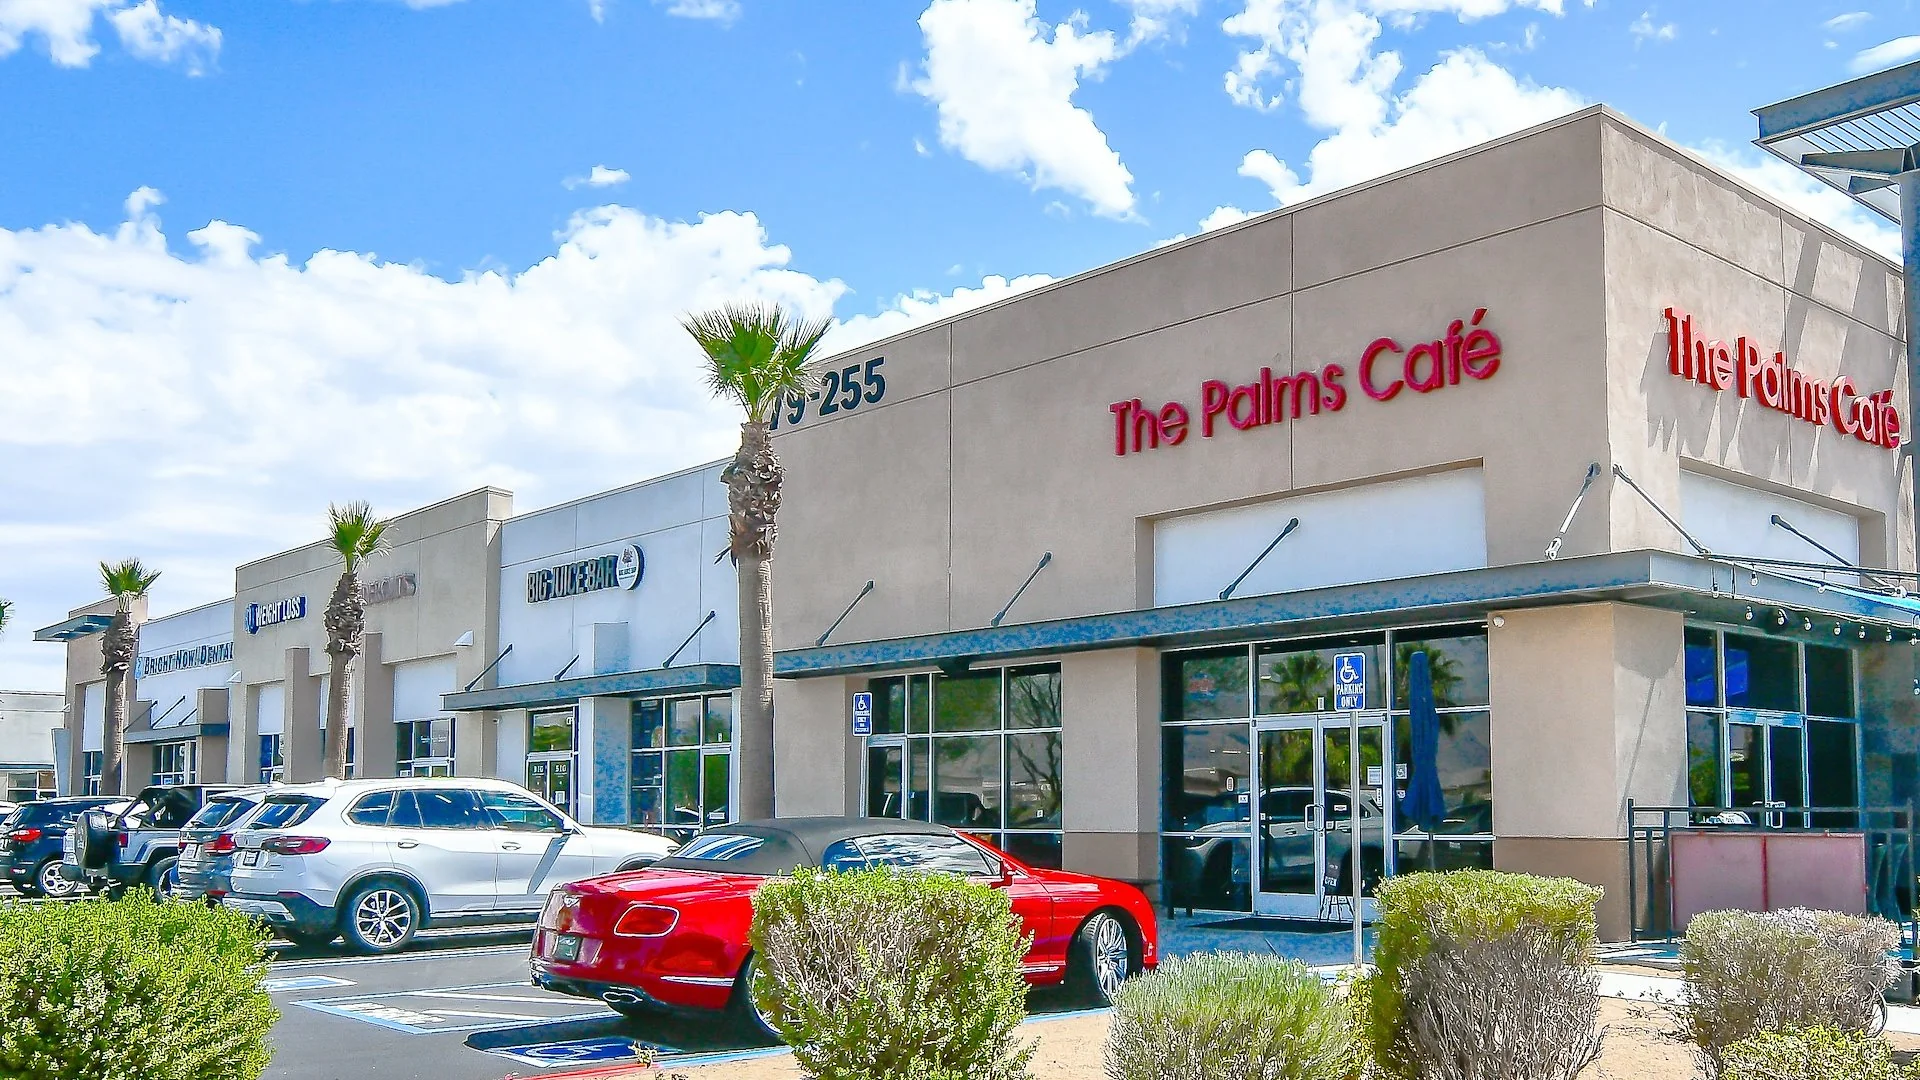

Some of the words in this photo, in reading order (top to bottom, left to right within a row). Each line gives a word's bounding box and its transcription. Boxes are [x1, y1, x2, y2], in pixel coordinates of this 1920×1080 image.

[1109, 397, 1189, 456] The
[1201, 363, 1347, 437] Palms
[1358, 307, 1501, 401] Café
[1665, 307, 1734, 391] The
[1736, 335, 1830, 425] Palms
[1830, 375, 1902, 449] Café
[527, 569, 550, 603] BIG
[549, 560, 588, 598] JUICE
[586, 554, 619, 591] BAR
[255, 601, 282, 627] WEIGHT
[281, 596, 301, 621] LOSS
[144, 653, 175, 675] BRIGHT
[1337, 683, 1363, 695] PARKING
[1341, 696, 1358, 707] ONLY
